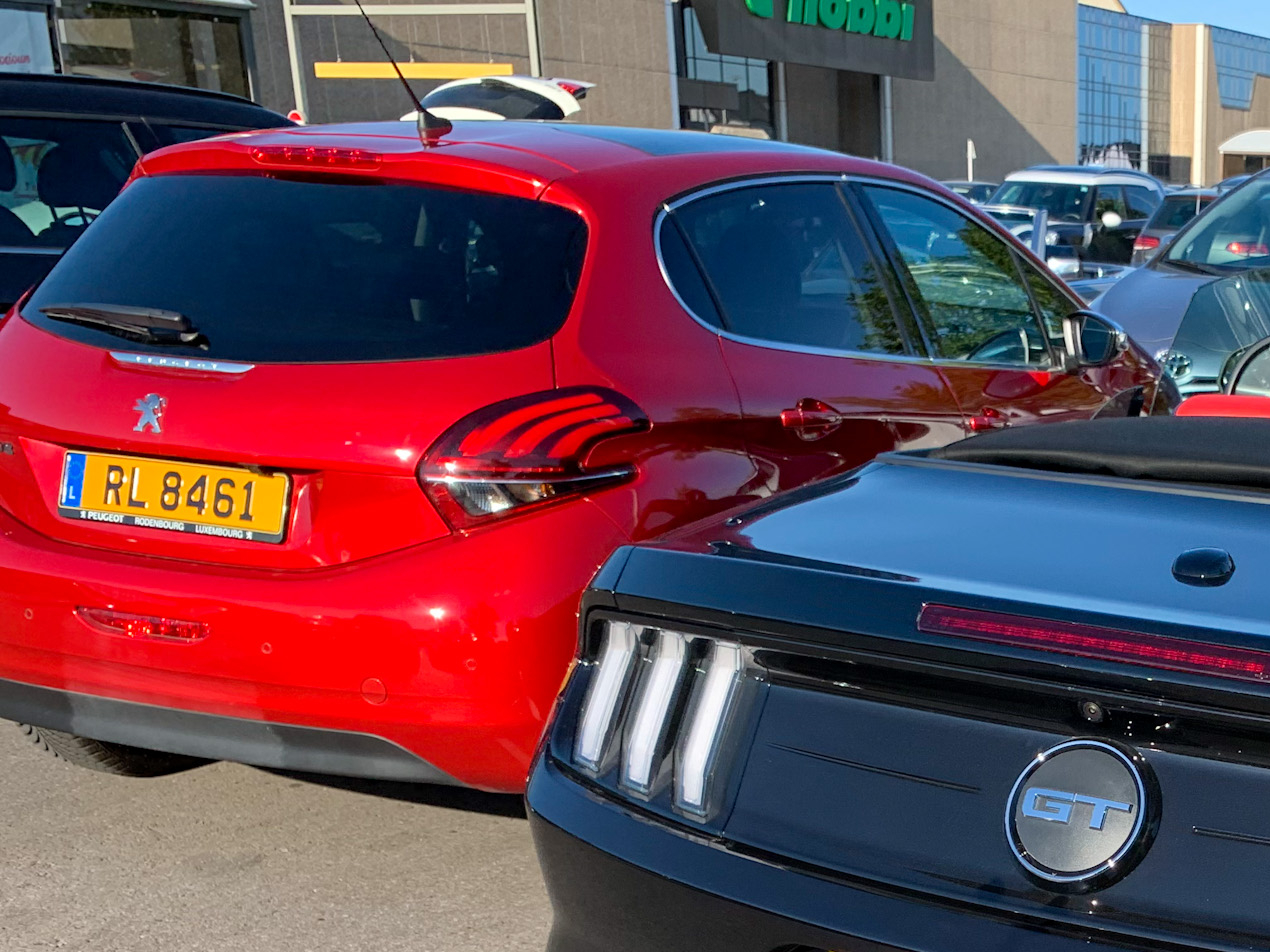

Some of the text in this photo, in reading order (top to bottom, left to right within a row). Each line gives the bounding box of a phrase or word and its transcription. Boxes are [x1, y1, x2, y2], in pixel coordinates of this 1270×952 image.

[68, 486, 76, 500] L
[104, 465, 256, 522] RL 8461
[88, 511, 243, 539] PEUGEOT RODENBOURG LUXEMBOURG
[1021, 786, 1134, 832] GT
